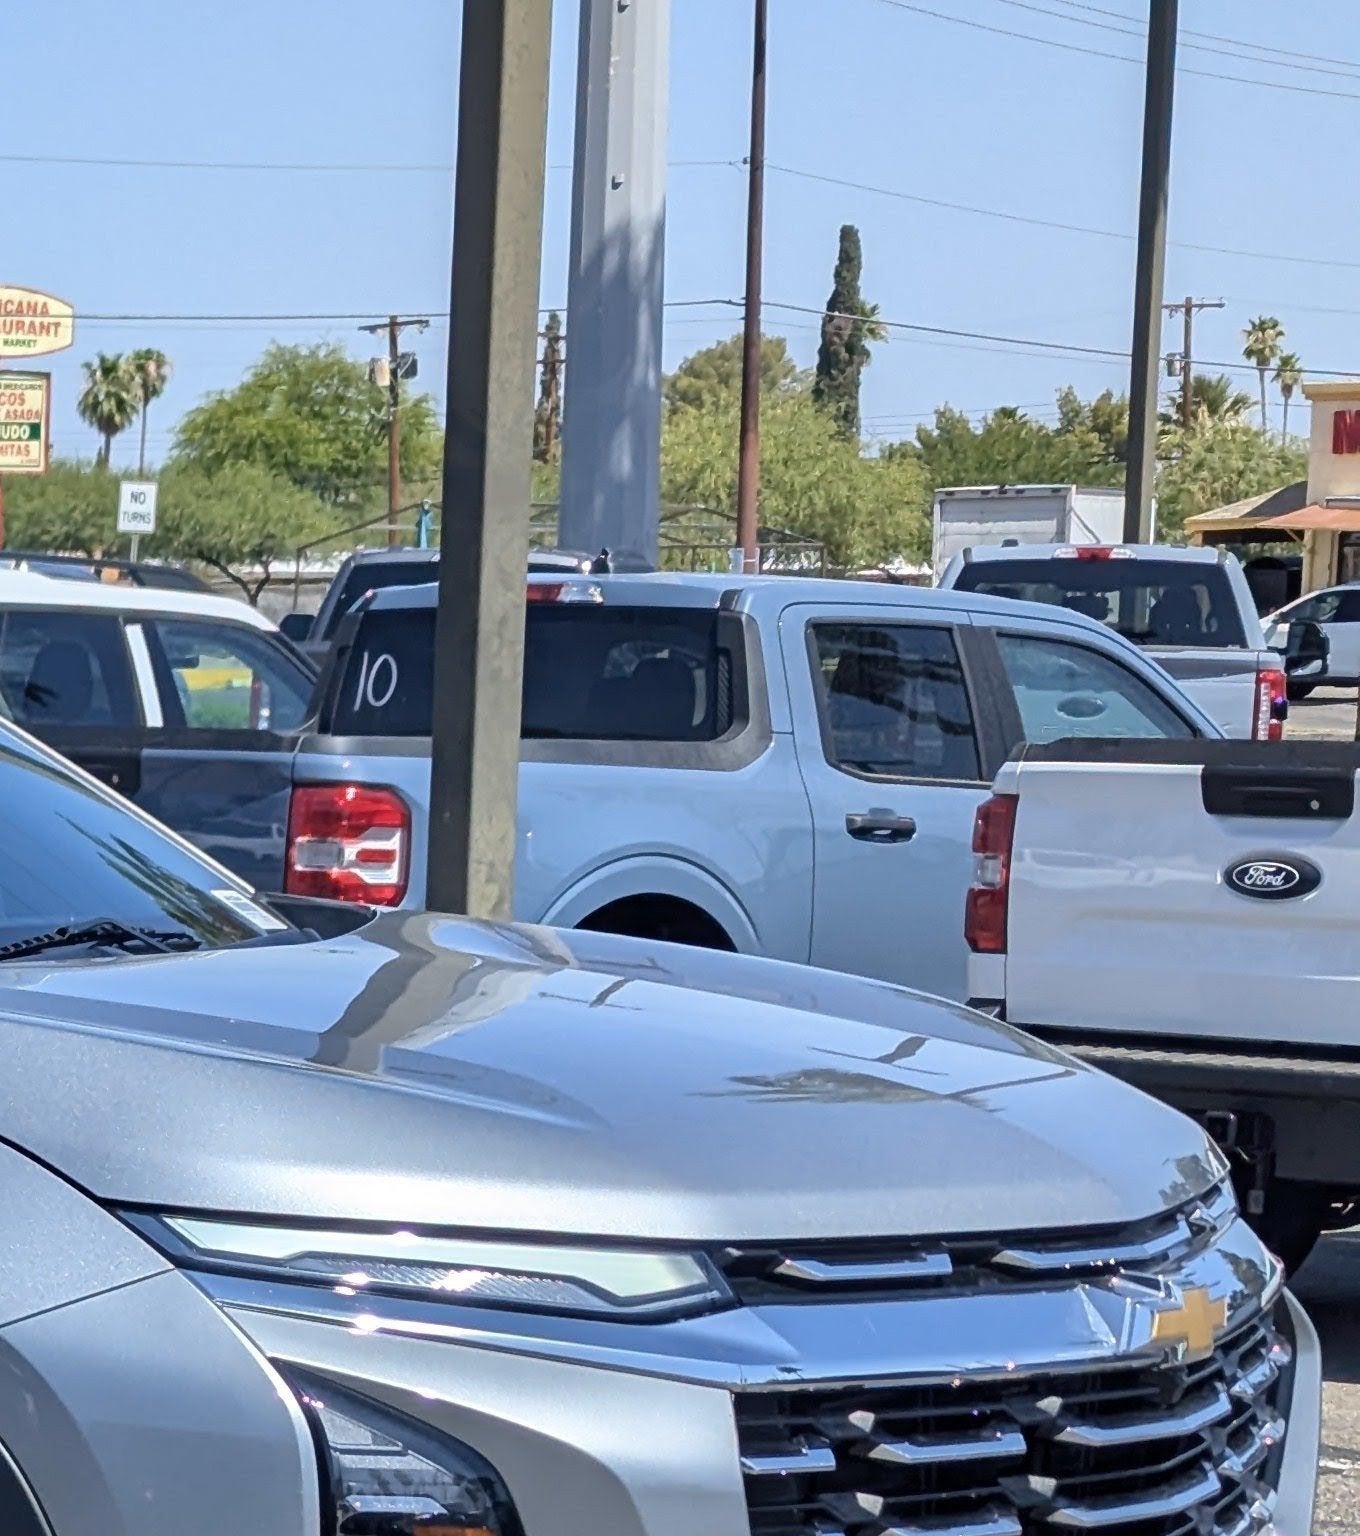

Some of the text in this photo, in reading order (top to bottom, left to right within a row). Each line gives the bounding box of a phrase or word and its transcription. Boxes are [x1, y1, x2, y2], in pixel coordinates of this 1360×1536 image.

[4, 408, 41, 421] ASADA
[130, 490, 146, 505] NO
[122, 511, 152, 525] TURNS
[353, 651, 398, 711] 10
[1244, 865, 1287, 886] Ford
